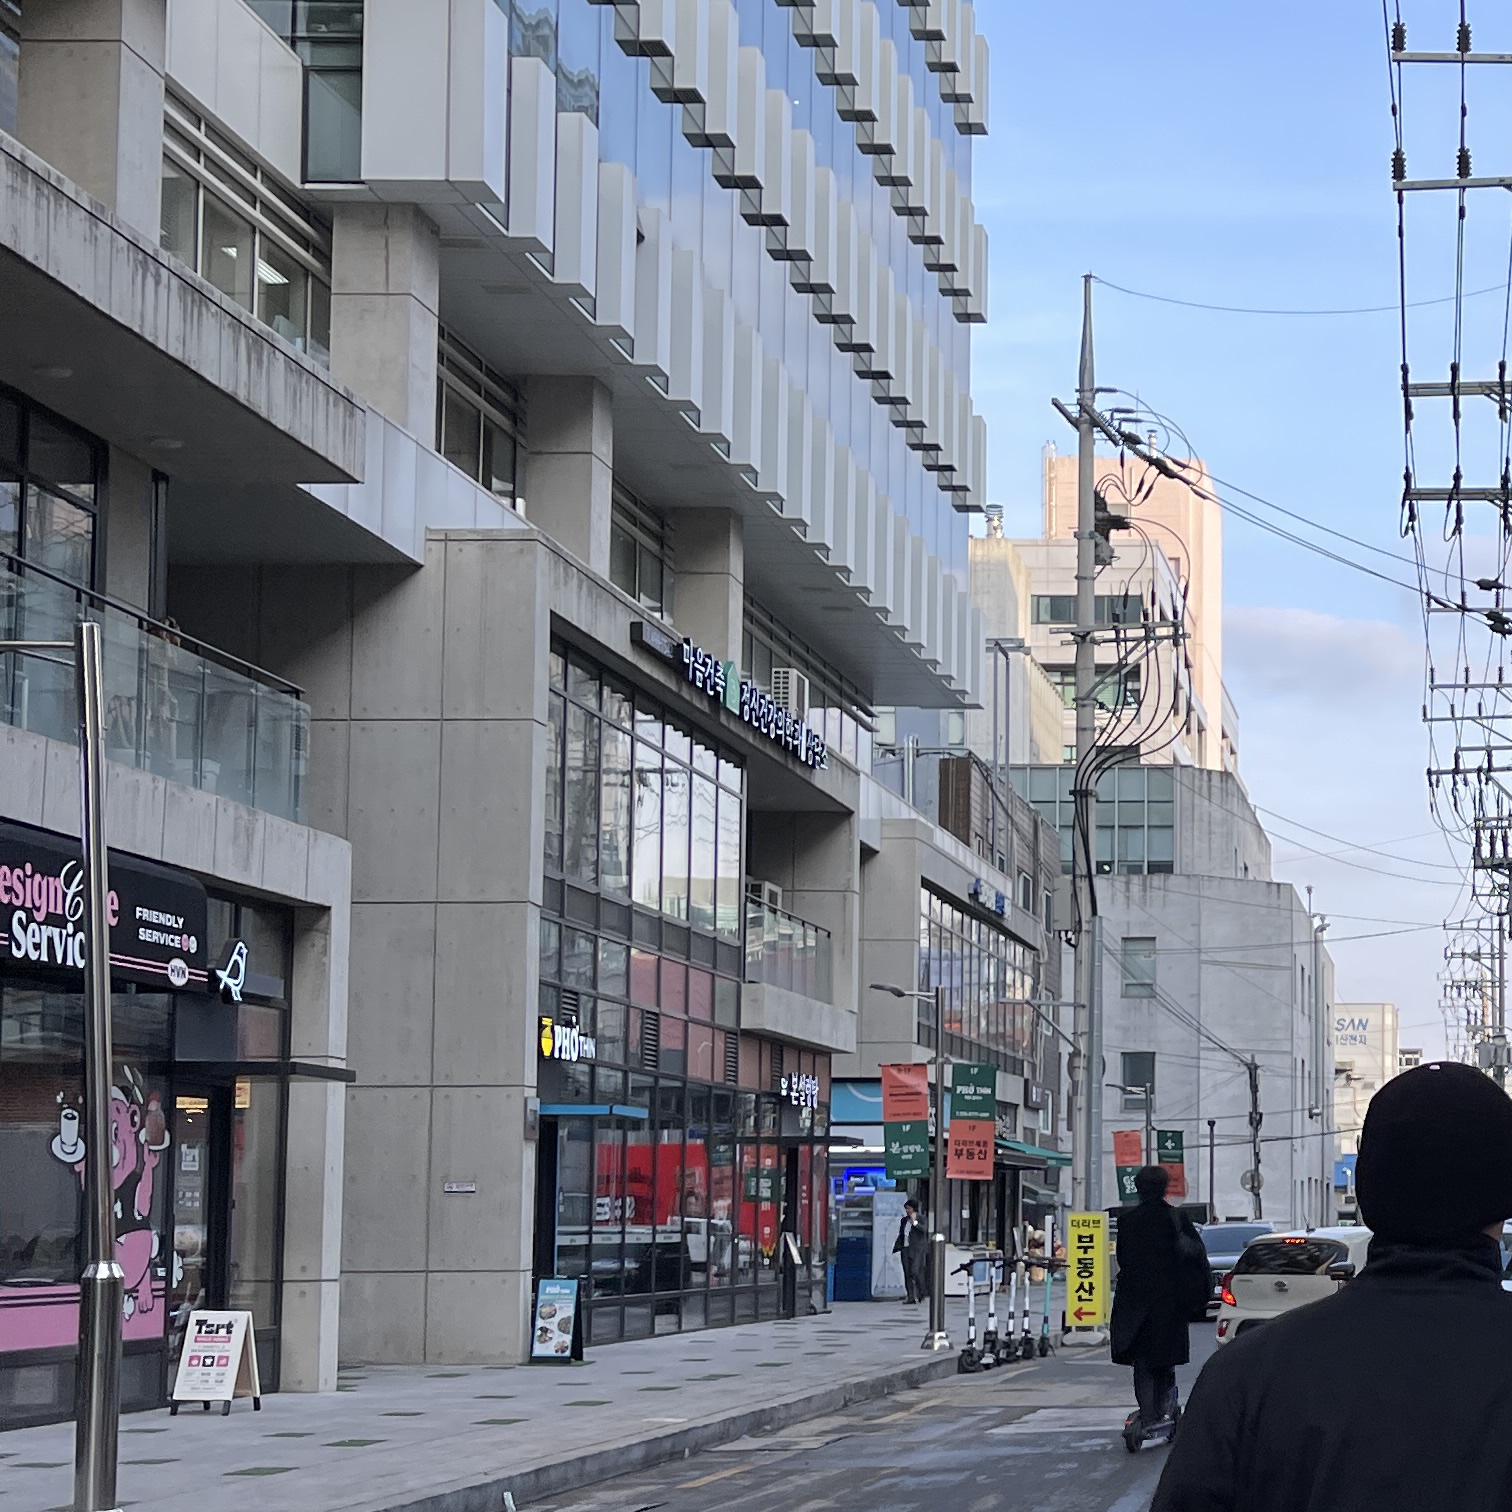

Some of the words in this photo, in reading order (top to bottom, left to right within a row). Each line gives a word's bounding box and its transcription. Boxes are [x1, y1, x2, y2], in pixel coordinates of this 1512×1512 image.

[683, 638, 726, 703] 마음건축
[741, 681, 802, 757] 정신건강의학과
[135, 906, 184, 929] FRIENDLY
[139, 927, 182, 949] SERVICE
[12, 910, 86, 969] Servic
[1071, 1219, 1101, 1228] 더리브
[1075, 1233, 1096, 1302] 부동산
